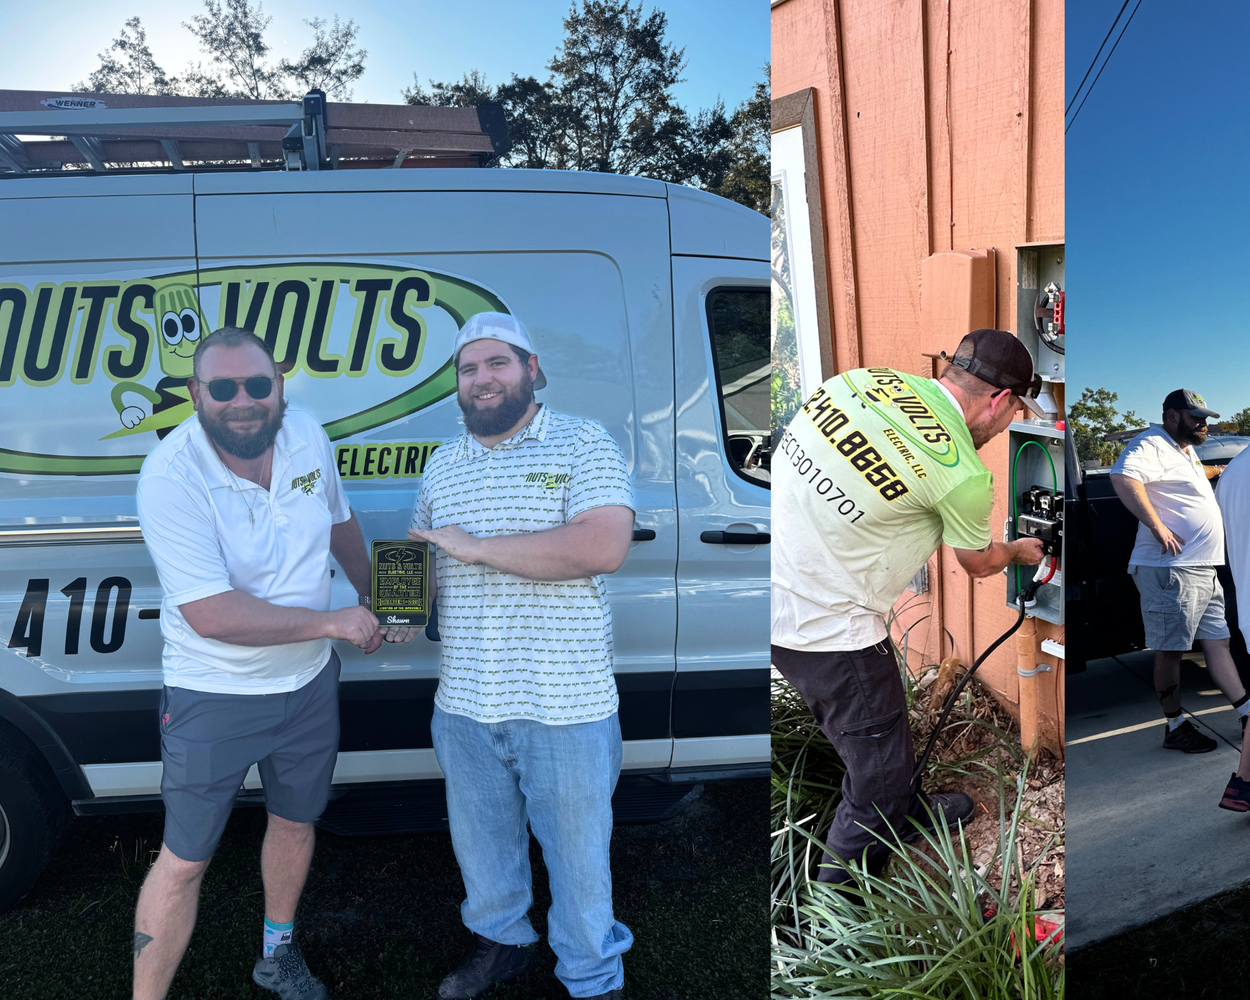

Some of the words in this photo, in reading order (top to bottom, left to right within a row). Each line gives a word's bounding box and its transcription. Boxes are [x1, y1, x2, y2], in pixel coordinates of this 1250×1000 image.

[55, 99, 96, 108] WERNER
[217, 276, 431, 374] VOLTS
[892, 395, 951, 444] VOLTS
[337, 445, 441, 477] ELECTRI
[525, 472, 548, 483] NUTS
[911, 463, 927, 479] LLC
[386, 615, 410, 624] Shawn
